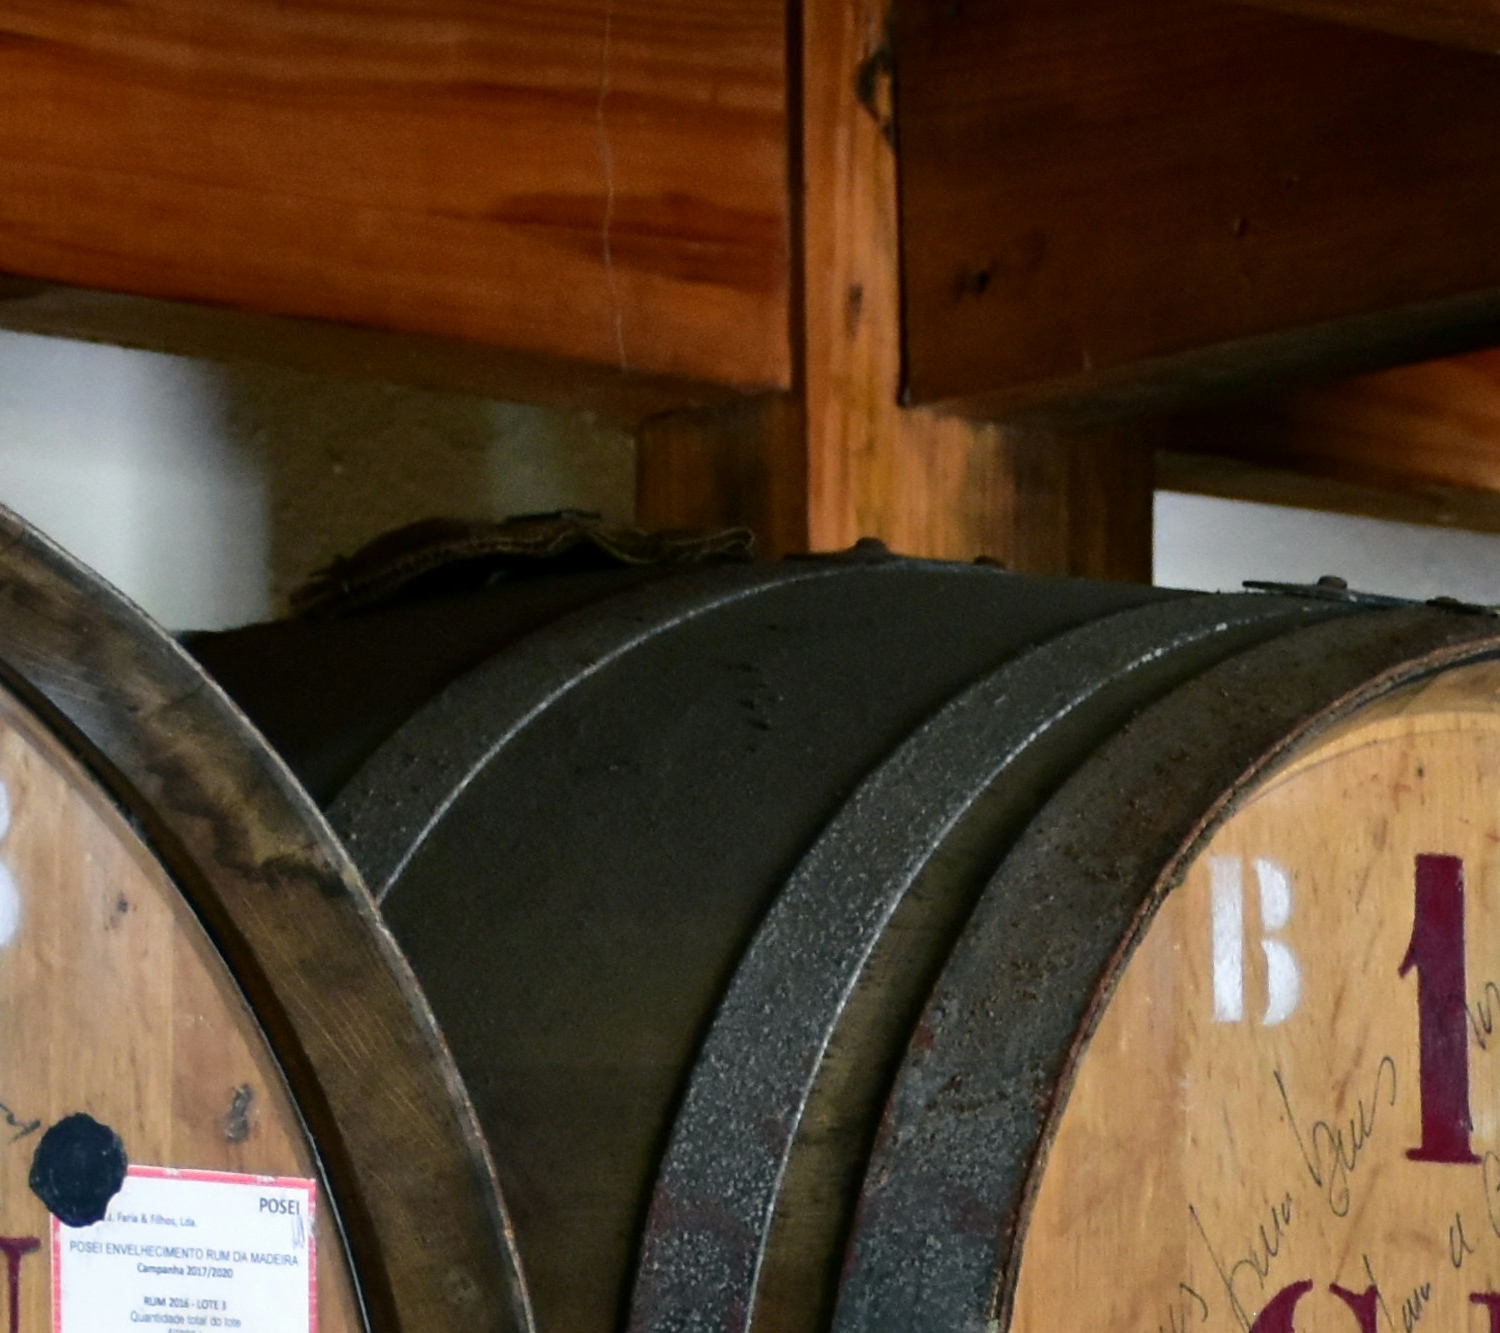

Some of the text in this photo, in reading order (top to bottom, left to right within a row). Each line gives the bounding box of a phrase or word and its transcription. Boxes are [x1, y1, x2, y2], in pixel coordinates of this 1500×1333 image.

[1209, 854, 1302, 1024] B
[260, 1197, 300, 1216] POSEI
[117, 1213, 139, 1225] Faria
[141, 1214, 148, 1225] &
[69, 1241, 299, 1267] POSEI ENVELHECIMENTO RUM DA MADEIRA
[137, 1262, 184, 1277] Campanha
